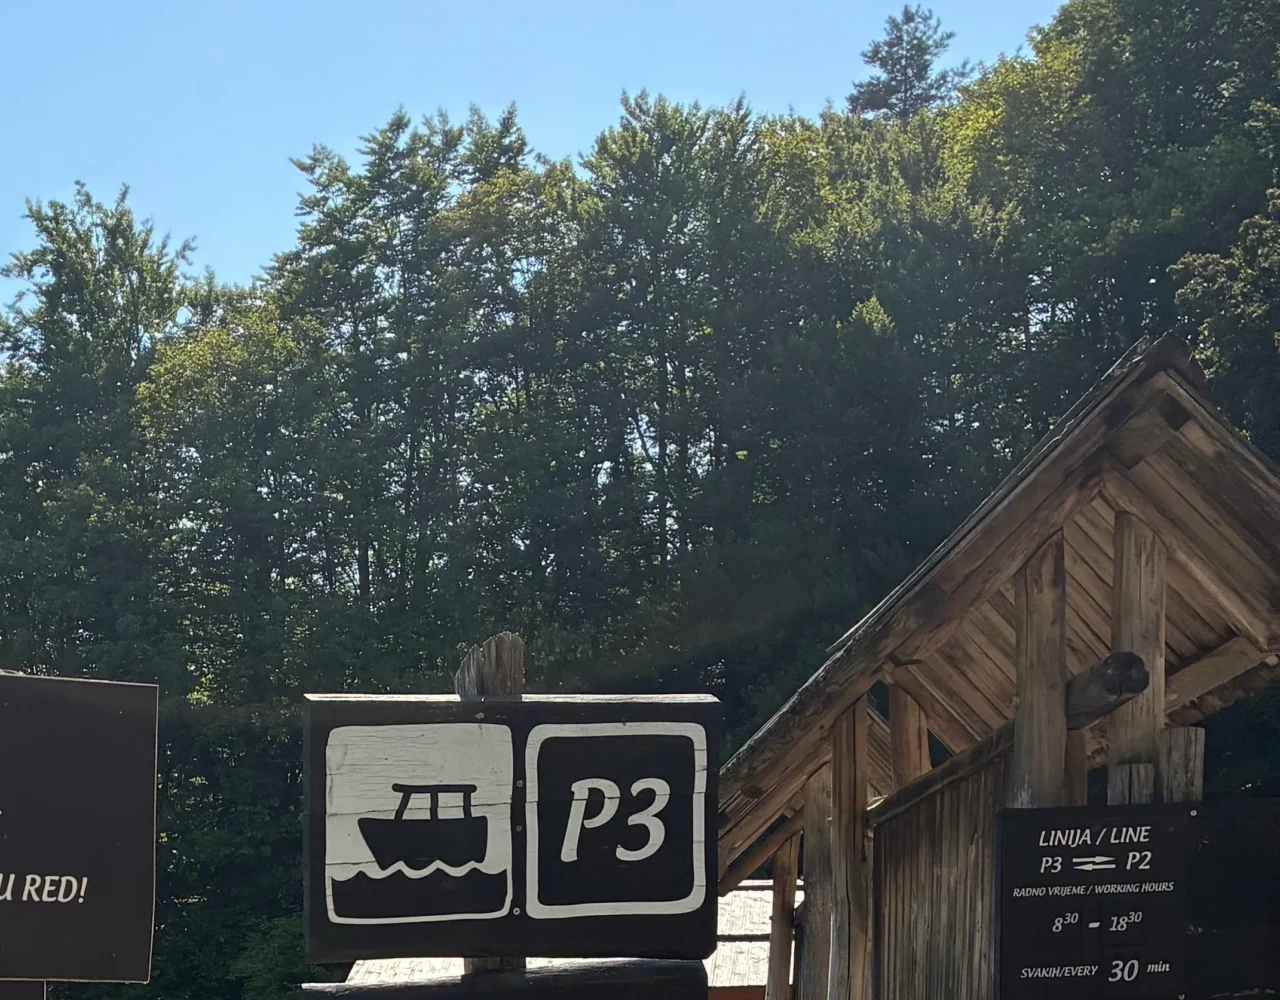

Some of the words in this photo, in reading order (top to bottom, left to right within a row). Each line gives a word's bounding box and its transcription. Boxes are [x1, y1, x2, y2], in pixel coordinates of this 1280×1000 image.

[560, 777, 671, 863] P3
[1038, 828, 1092, 848] LINIJA
[1110, 825, 1152, 844] LINE
[1040, 856, 1063, 874] P3
[1125, 850, 1152, 871] P2
[22, 874, 88, 904] RED!
[1013, 887, 1045, 896] RADNO
[1048, 886, 1086, 896] VRIJEME
[1095, 884, 1139, 893] WORKING
[1141, 882, 1174, 892] HOURS
[1021, 966, 1098, 978] SVAKIH/EVERY
[1108, 959, 1139, 982] 30
[1147, 961, 1169, 972] min
